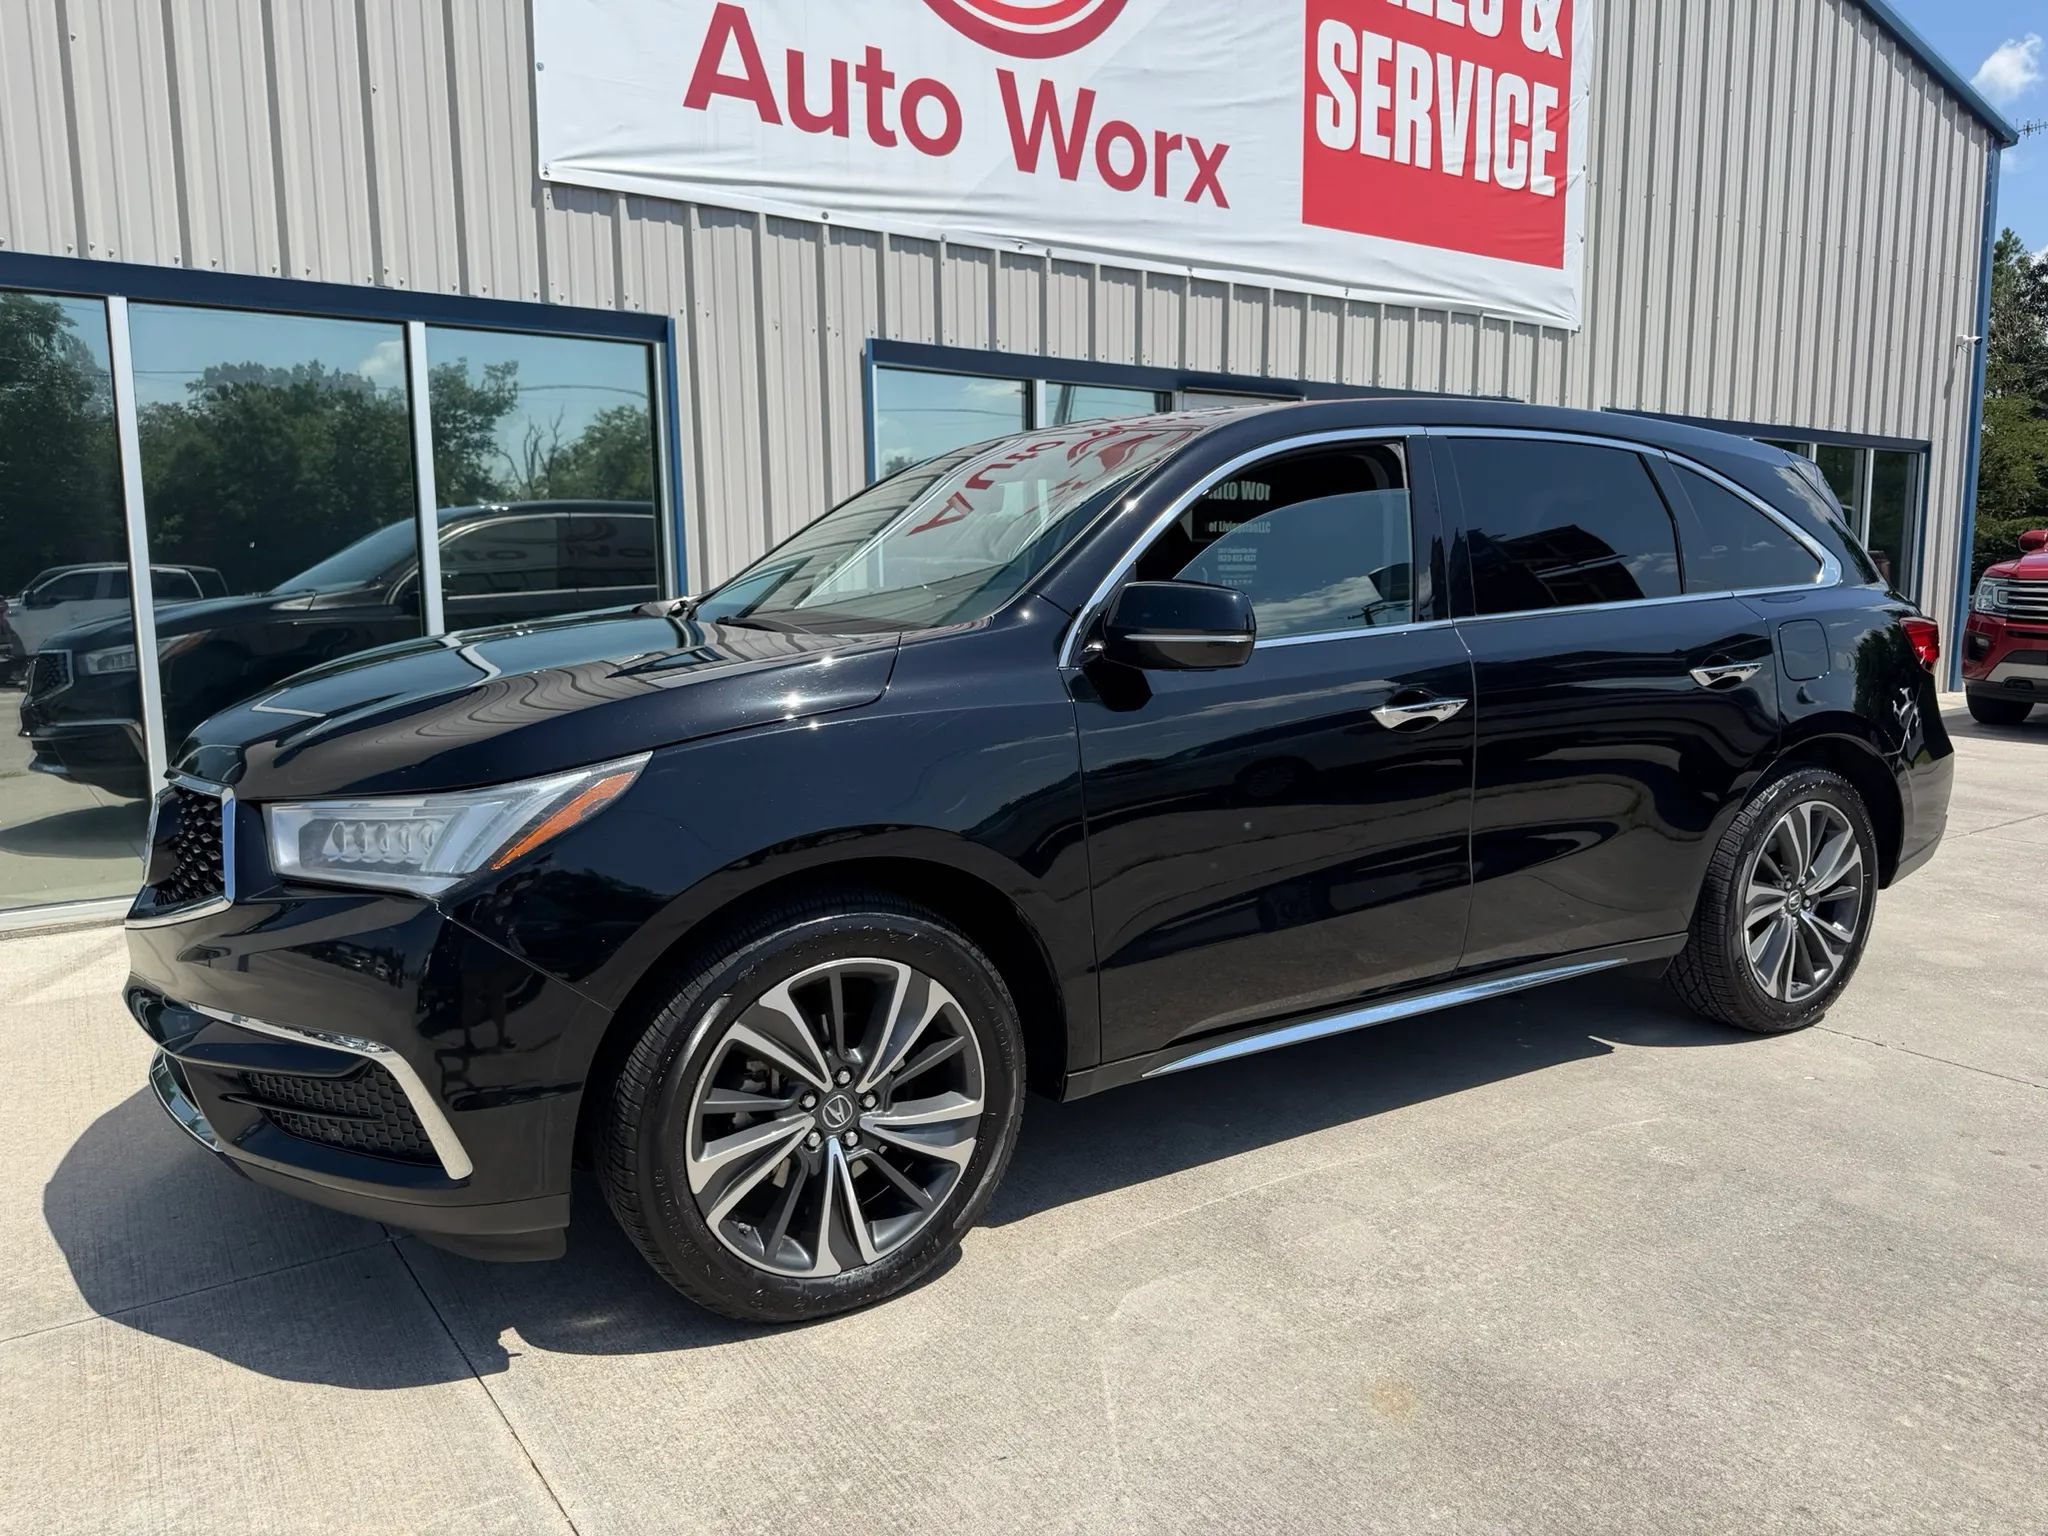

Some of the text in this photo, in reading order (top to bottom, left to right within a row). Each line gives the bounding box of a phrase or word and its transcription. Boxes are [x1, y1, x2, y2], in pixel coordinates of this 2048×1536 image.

[682, 2, 1230, 210] Auto Worx
[1315, 19, 1560, 198] SERVICE
[1208, 481, 1238, 500] uto
